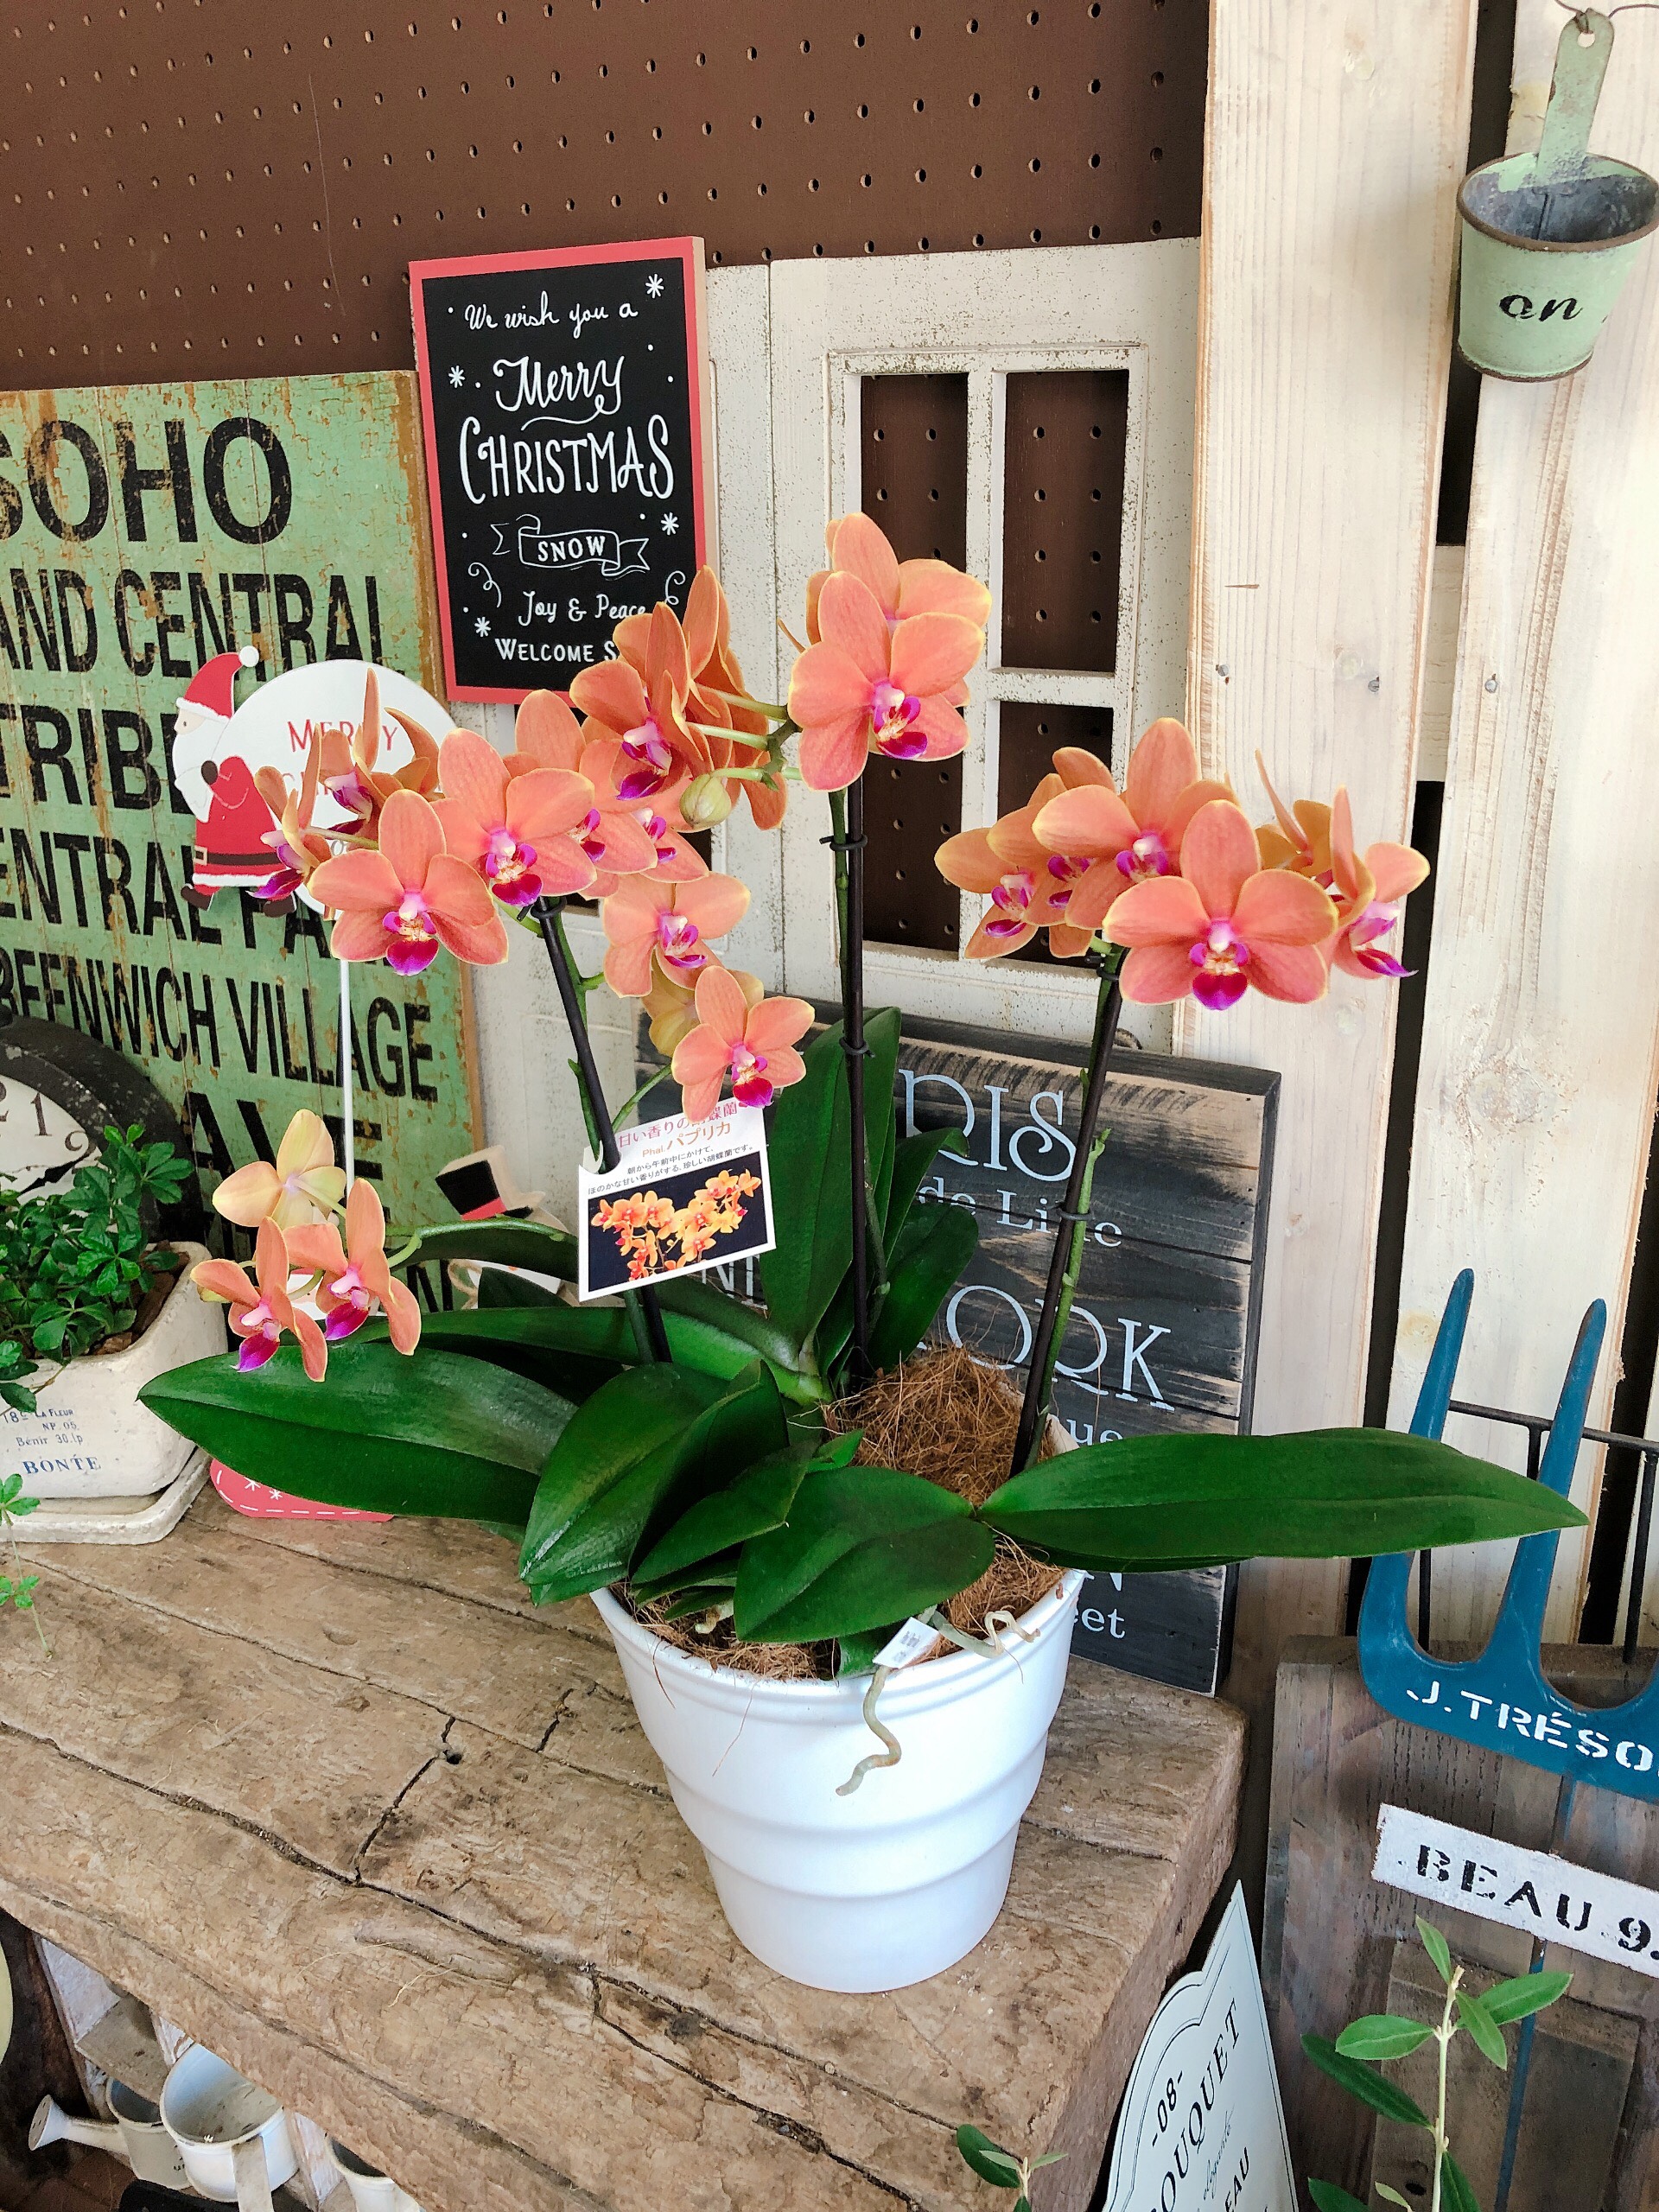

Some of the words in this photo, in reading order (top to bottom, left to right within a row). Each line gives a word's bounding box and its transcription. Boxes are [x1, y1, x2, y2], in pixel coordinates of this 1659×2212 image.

[465, 303, 498, 330] We
[505, 290, 559, 328] wish
[569, 303, 608, 339] you
[619, 303, 638, 318] a
[493, 356, 626, 420] Merry
[459, 414, 675, 505] CHRISTMAS
[537, 536, 606, 563] SNOW
[518, 591, 556, 626] Joy
[569, 598, 587, 621] &
[495, 638, 594, 663] WELCOME
[226, 977, 438, 1103] VILLAGE
[898, 1068, 1077, 1182] RIS
[996, 1189, 1122, 1248] Lie
[946, 1285, 1175, 1412] ORK
[1417, 1844, 1592, 1931] BEAU
[1150, 1998, 1239, 2212] OUQUET
